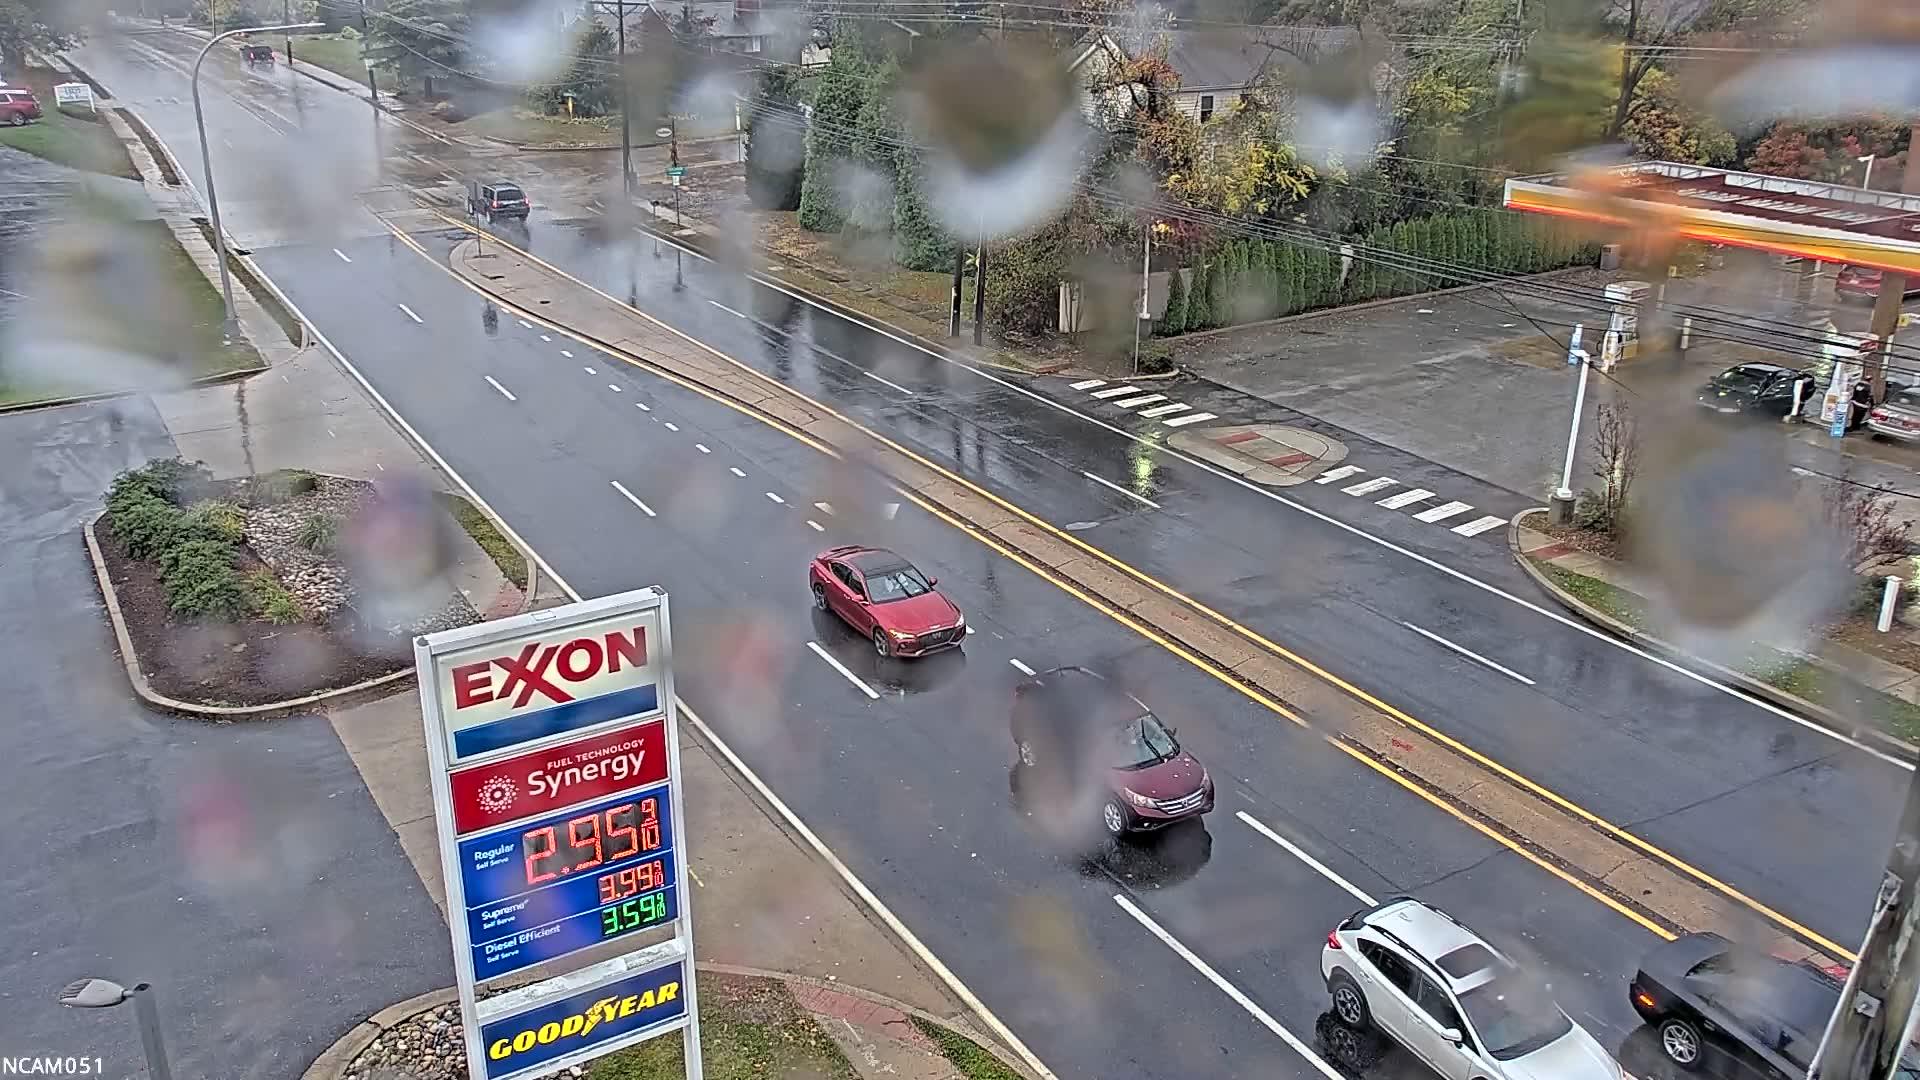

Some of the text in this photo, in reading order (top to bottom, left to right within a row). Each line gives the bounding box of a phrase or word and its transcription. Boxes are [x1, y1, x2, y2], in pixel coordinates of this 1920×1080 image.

[452, 626, 648, 709] EXXON
[547, 738, 645, 770] FUEL TECHNOLOGY
[527, 750, 646, 798] Synergy
[474, 844, 514, 860] Regular
[599, 862, 653, 905] 3.99
[603, 895, 656, 934] 3.59
[485, 925, 560, 954] Diesel Efficient
